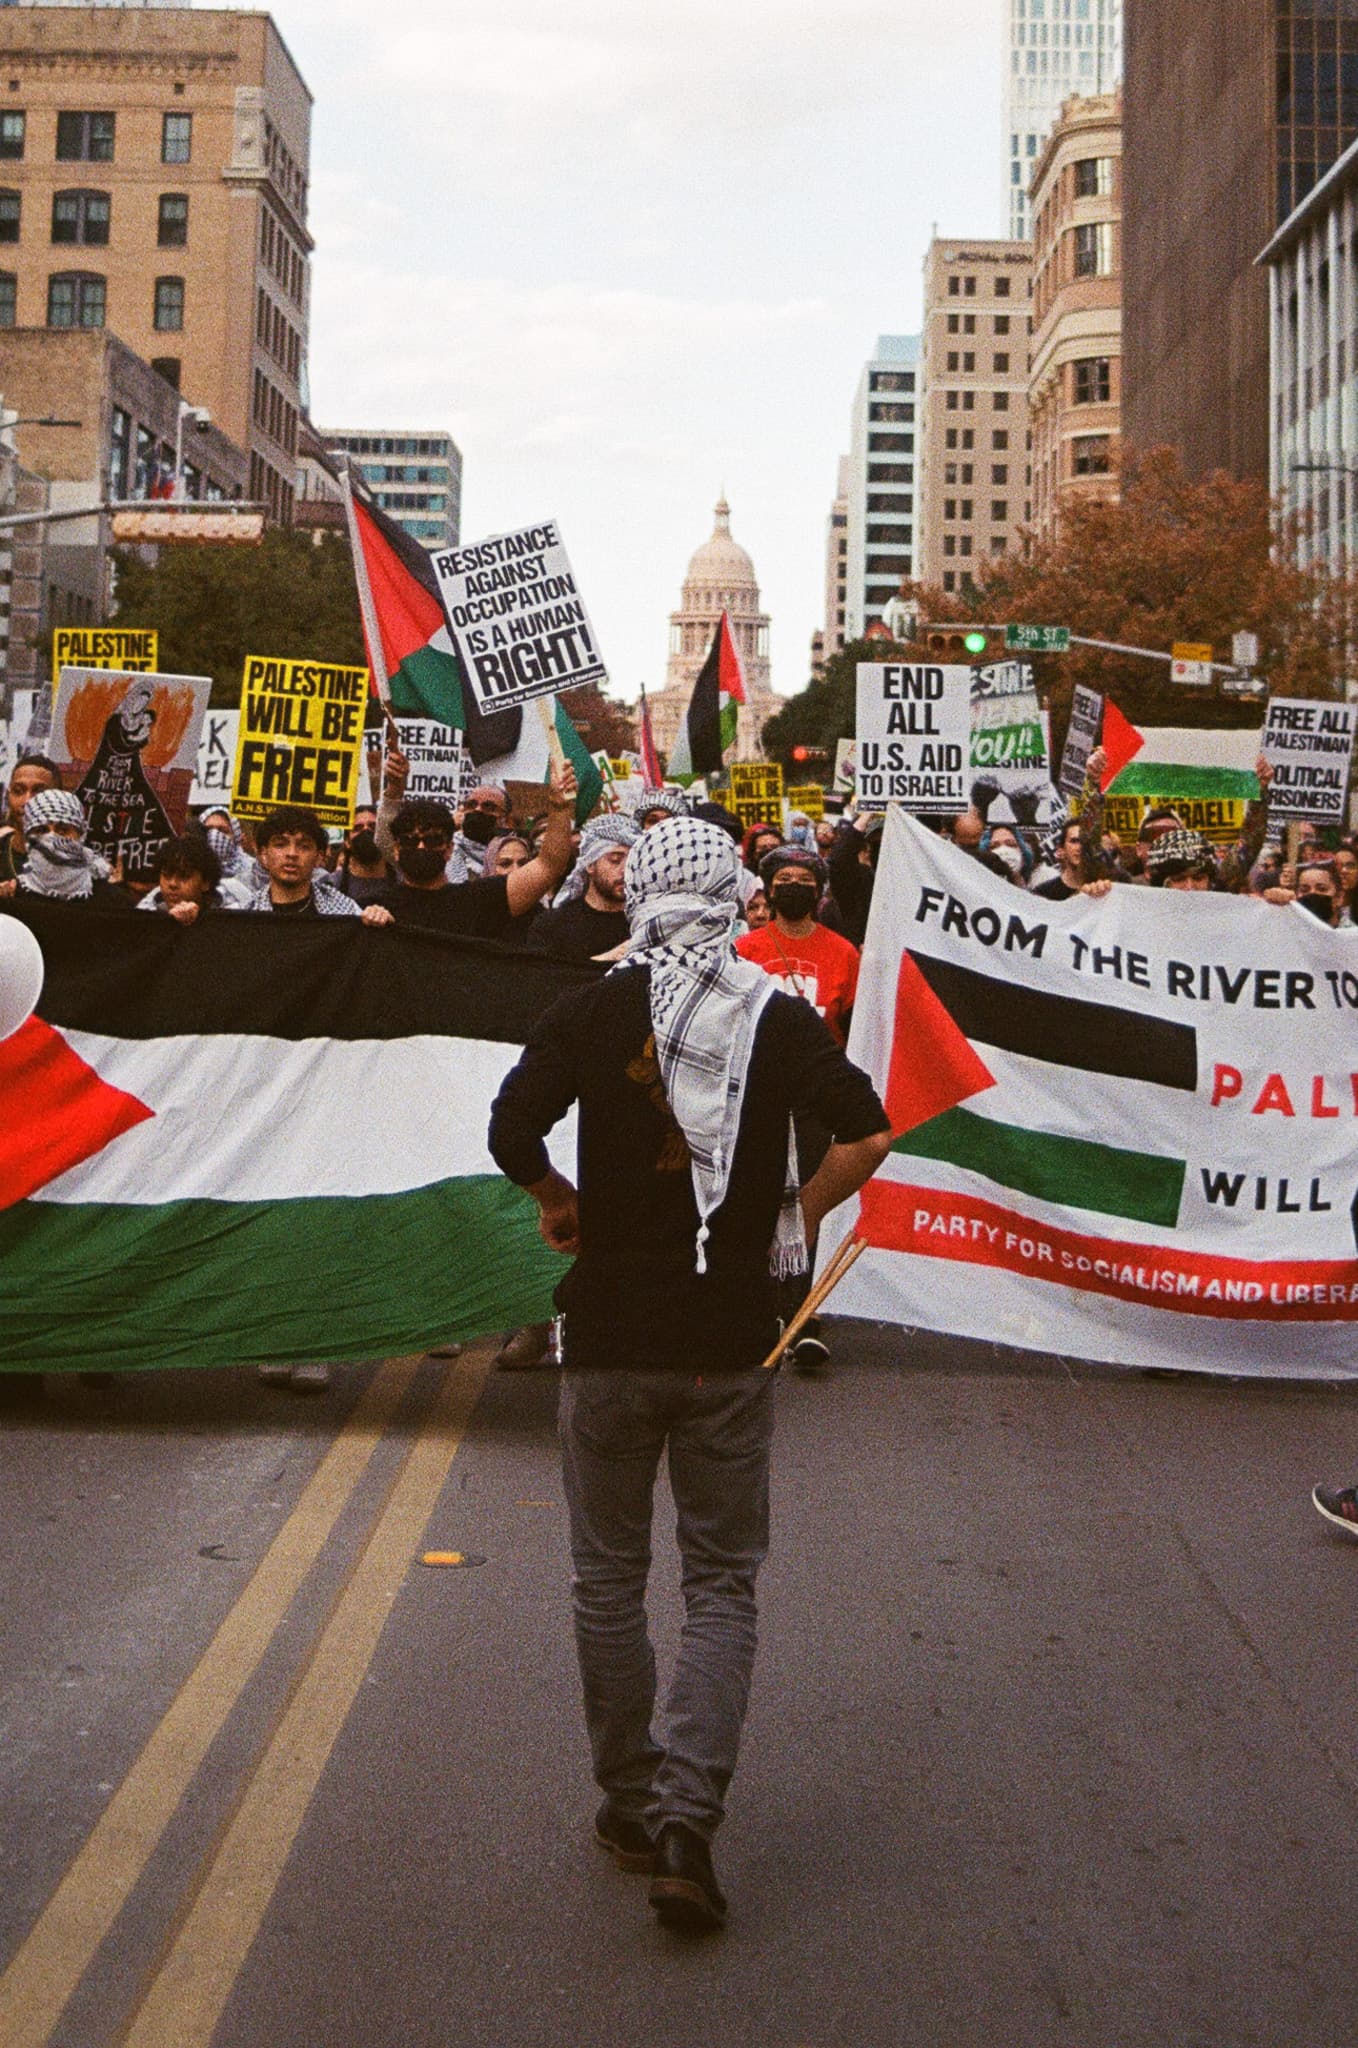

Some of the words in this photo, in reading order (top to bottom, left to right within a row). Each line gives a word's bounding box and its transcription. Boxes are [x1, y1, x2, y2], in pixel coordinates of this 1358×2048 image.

[437, 525, 559, 579] RESISTANCE
[465, 554, 548, 598] AGAINST
[452, 573, 576, 628] OCCUPATION
[58, 633, 154, 658] PALESTINE
[466, 630, 488, 655] IS
[492, 625, 508, 648] A
[507, 600, 585, 642] HUMAN
[473, 624, 597, 697] RIGHT!
[248, 661, 365, 703] PALESTINE
[884, 667, 944, 700] END
[247, 694, 313, 739] WILL
[321, 702, 361, 744] BE
[398, 726, 425, 746] REE
[430, 727, 459, 746] ALL
[887, 702, 939, 735] ALL
[1268, 706, 1316, 731] FREE
[1318, 710, 1351, 734] ALL
[862, 743, 911, 771] U.S.
[919, 744, 962, 772] AID
[1265, 731, 1350, 754] PALESTINIAN
[237, 740, 353, 807] FREE!
[860, 774, 883, 796] TO
[889, 775, 963, 796] ISRAEL!
[1274, 764, 1343, 789] OLITICAL
[1270, 788, 1341, 810] RISONERS
[914, 886, 1048, 958] FROM
[1070, 934, 1151, 988] THE
[1168, 960, 1314, 1009] RIVER
[1200, 1168, 1331, 1213] WILL
[913, 1209, 999, 1243] PARTY
[1005, 1231, 1053, 1262] FOR
[1061, 1251, 1200, 1297] SOCIALISM
[1203, 1279, 1264, 1302] AND
